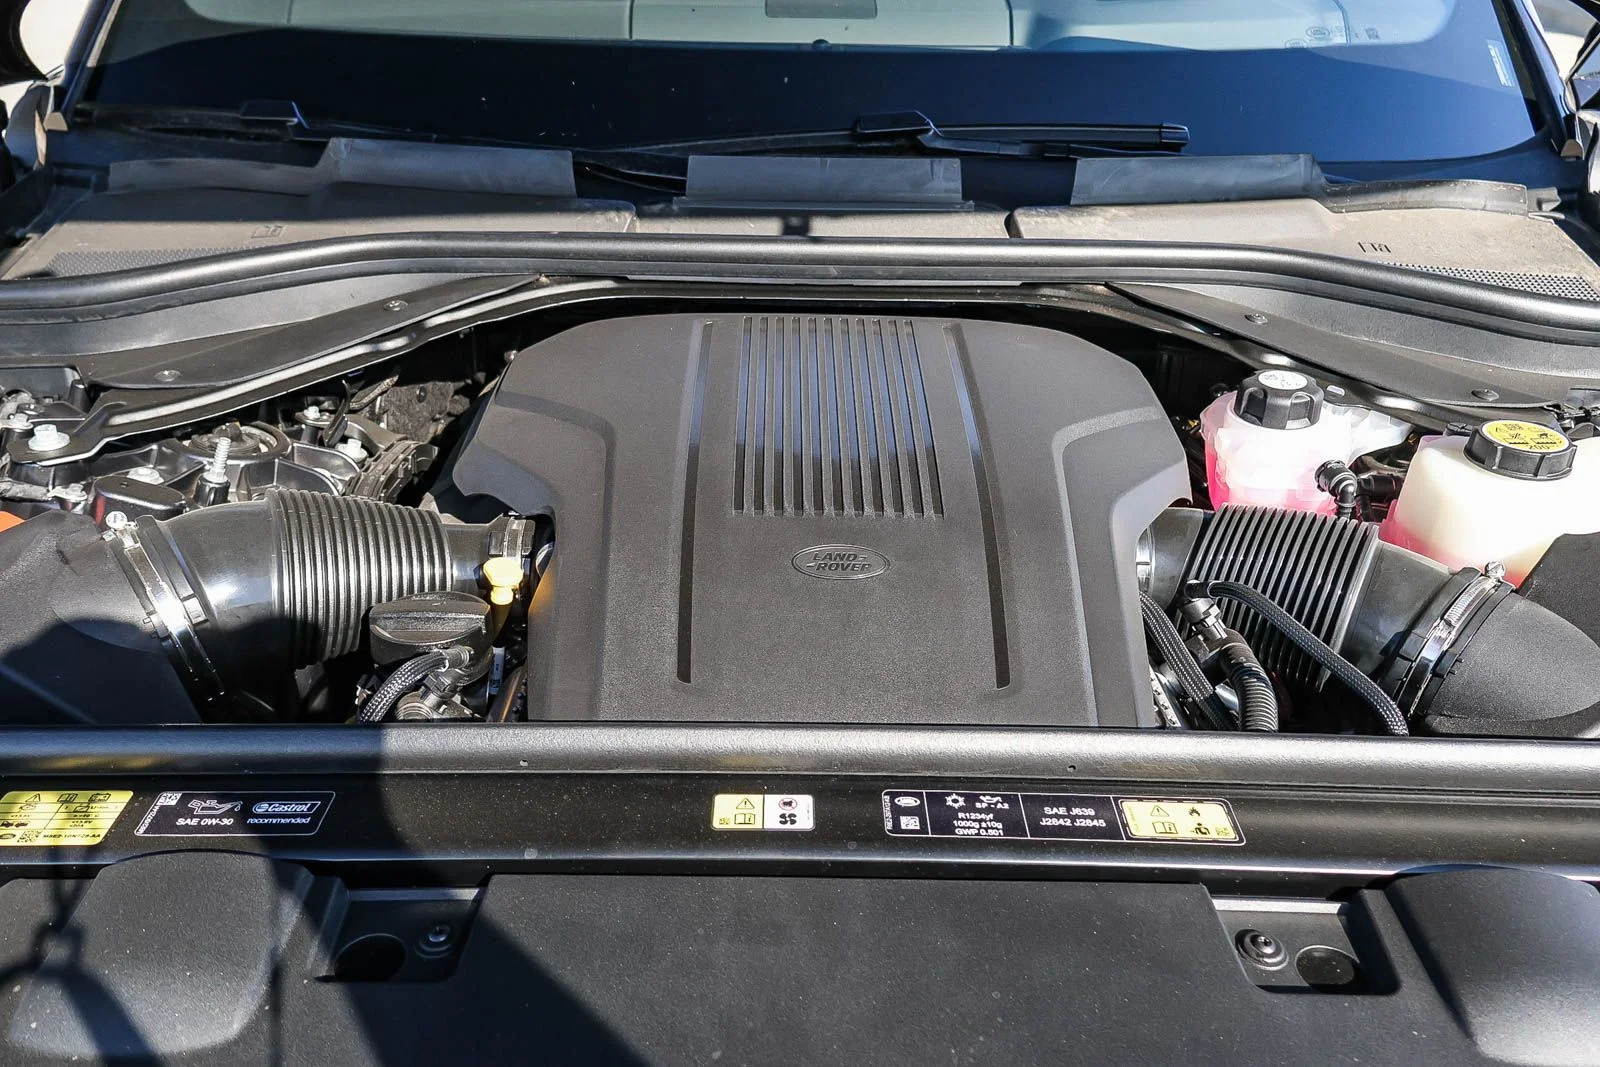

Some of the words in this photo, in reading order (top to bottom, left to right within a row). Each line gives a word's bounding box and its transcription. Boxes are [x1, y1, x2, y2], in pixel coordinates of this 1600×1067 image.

[813, 552, 858, 562] LAND
[816, 562, 872, 572] ROVER
[267, 803, 312, 812] Castrol
[1043, 806, 1068, 815] SAE
[1070, 807, 1096, 816] J639
[957, 812, 994, 821] R1234yf
[175, 817, 201, 826] SAE
[200, 818, 234, 826] 0W-30
[953, 820, 980, 829] 1000g
[1040, 817, 1072, 826] J2842
[1074, 818, 1107, 827] J2845
[955, 828, 979, 836] GWP
[980, 828, 1004, 836] 0.501
